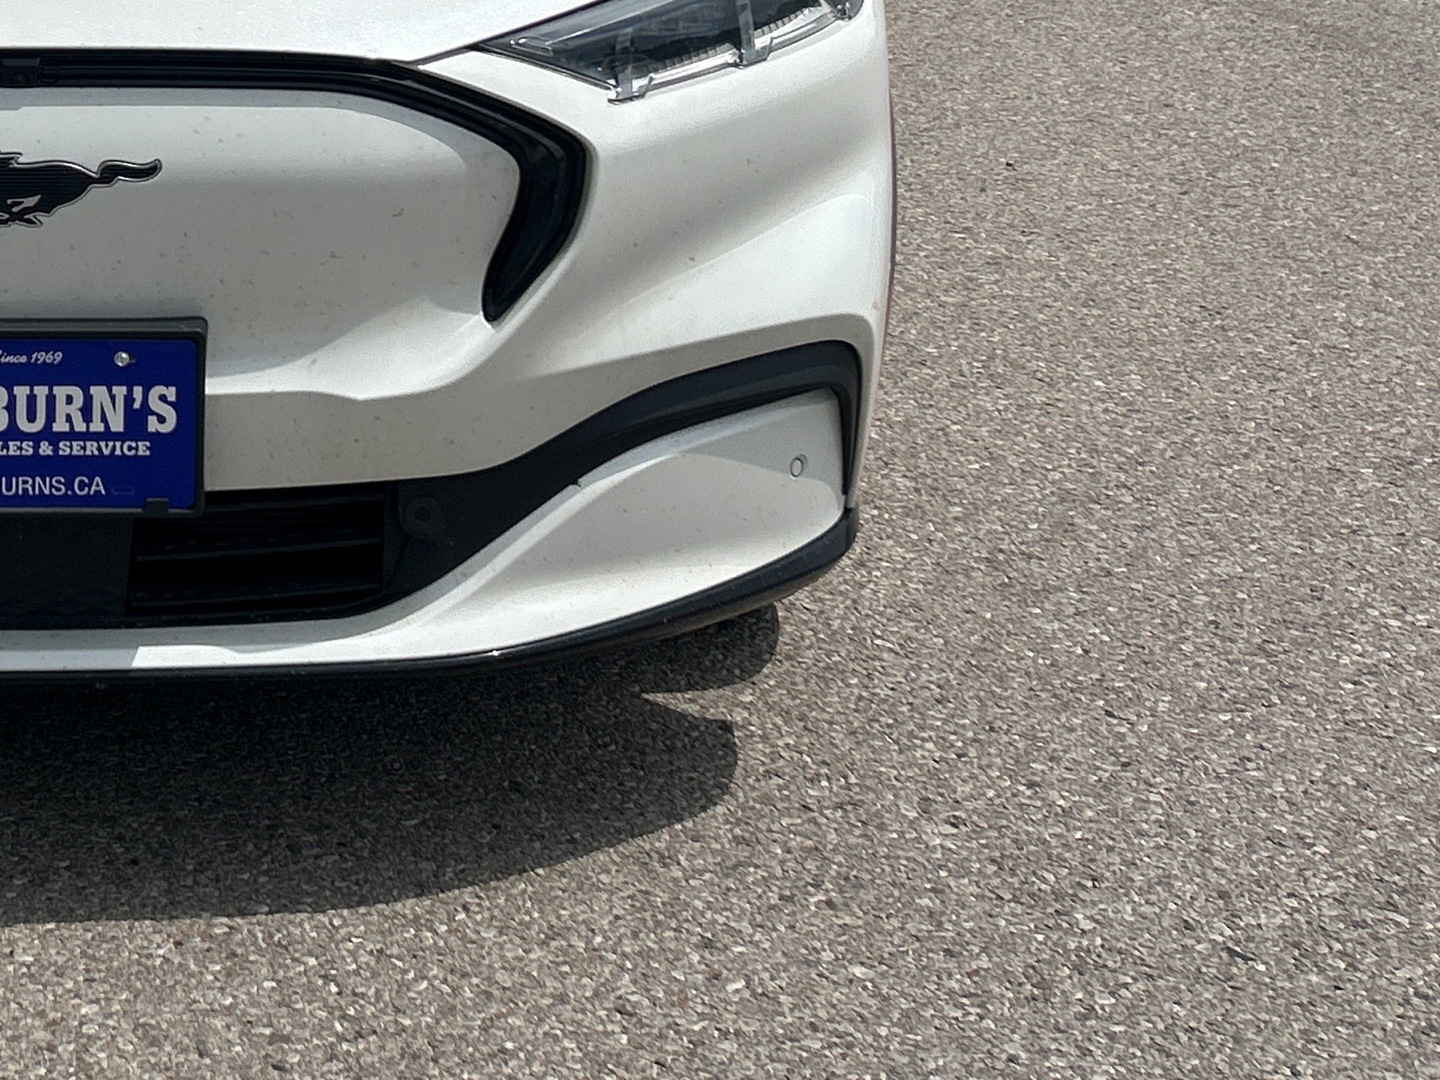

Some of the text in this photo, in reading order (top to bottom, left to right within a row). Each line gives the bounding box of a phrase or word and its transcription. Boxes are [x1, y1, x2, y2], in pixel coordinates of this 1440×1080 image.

[31, 350, 63, 365] 1969
[39, 441, 53, 456] &
[59, 441, 150, 456] SERVICE
